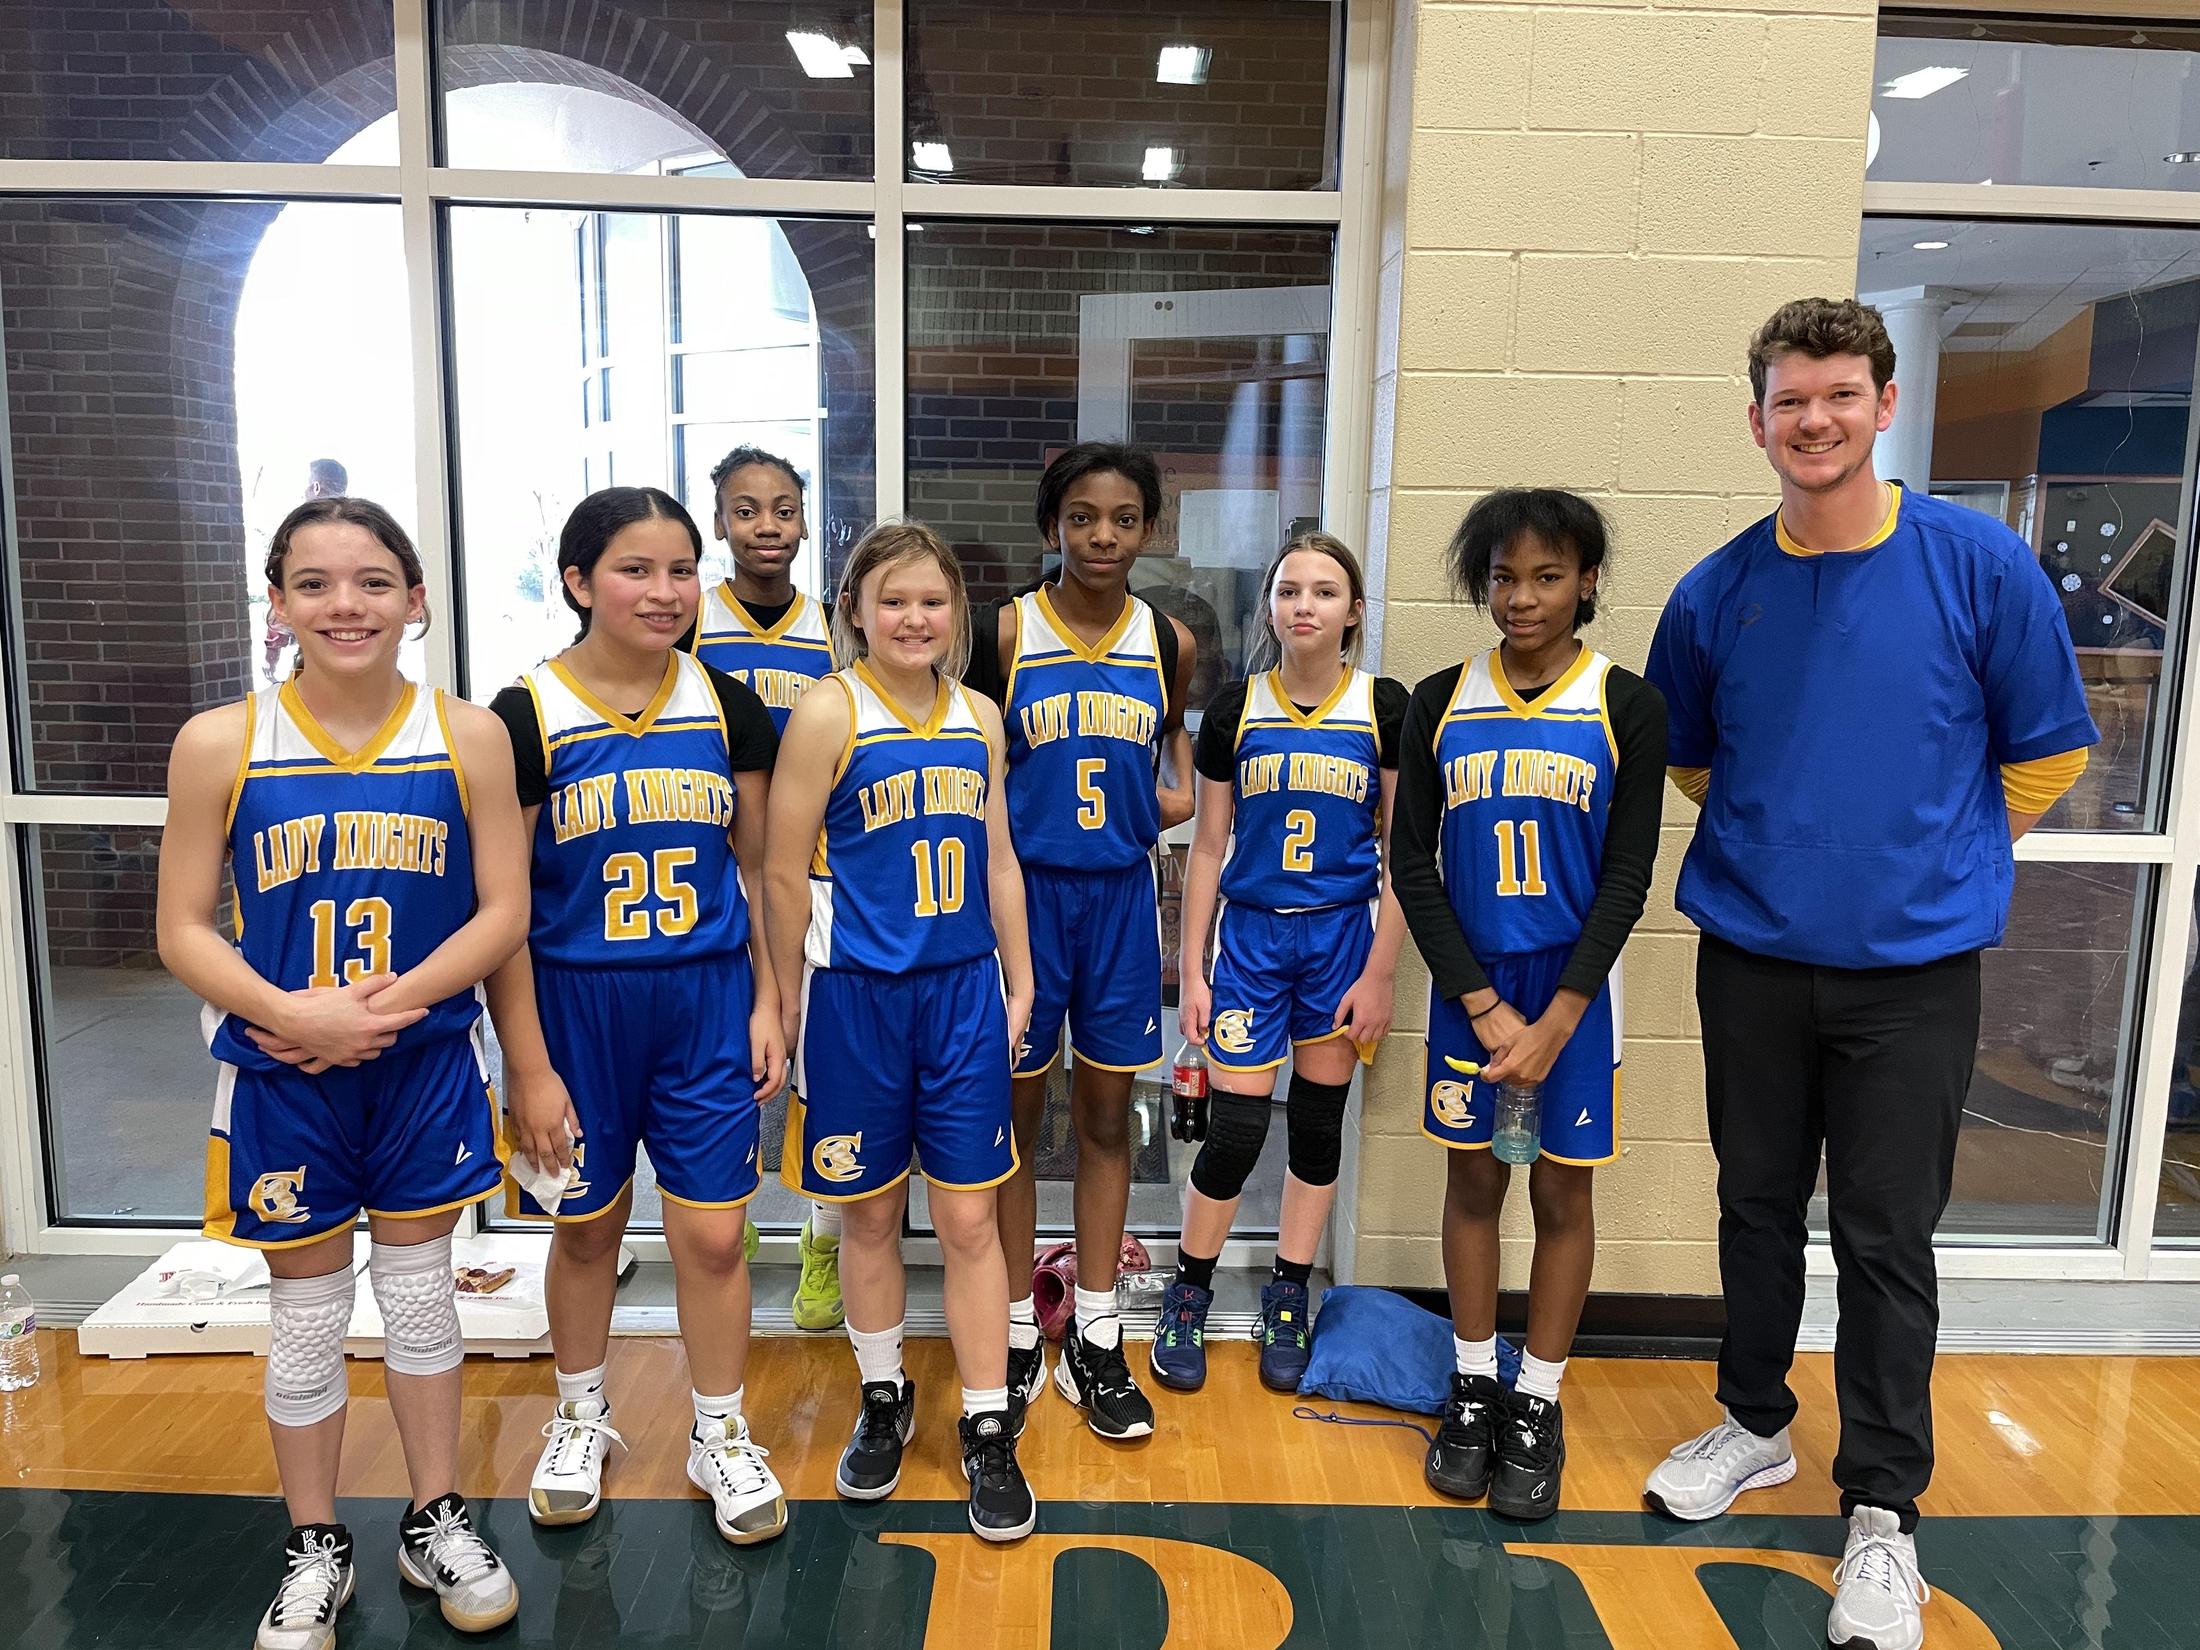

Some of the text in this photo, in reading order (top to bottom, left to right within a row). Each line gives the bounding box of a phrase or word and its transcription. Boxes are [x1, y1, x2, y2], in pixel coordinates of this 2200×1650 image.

[754, 668, 820, 710] KNIG
[1020, 691, 1157, 749] LADY KNIGHTS
[550, 768, 736, 844] LADY KNIGHTS
[857, 765, 986, 833] LADY KNIGHT
[1076, 758, 1106, 830] 5
[1240, 751, 1369, 804] LADY KNIGHTS
[1444, 748, 1597, 813] LADY KNIGHTS
[253, 811, 448, 893] LADY KNIGHTS
[1282, 809, 1317, 872] 2
[1493, 819, 1548, 896] 11
[603, 847, 698, 942] 25
[910, 837, 966, 918] 10
[308, 897, 393, 988] 13
